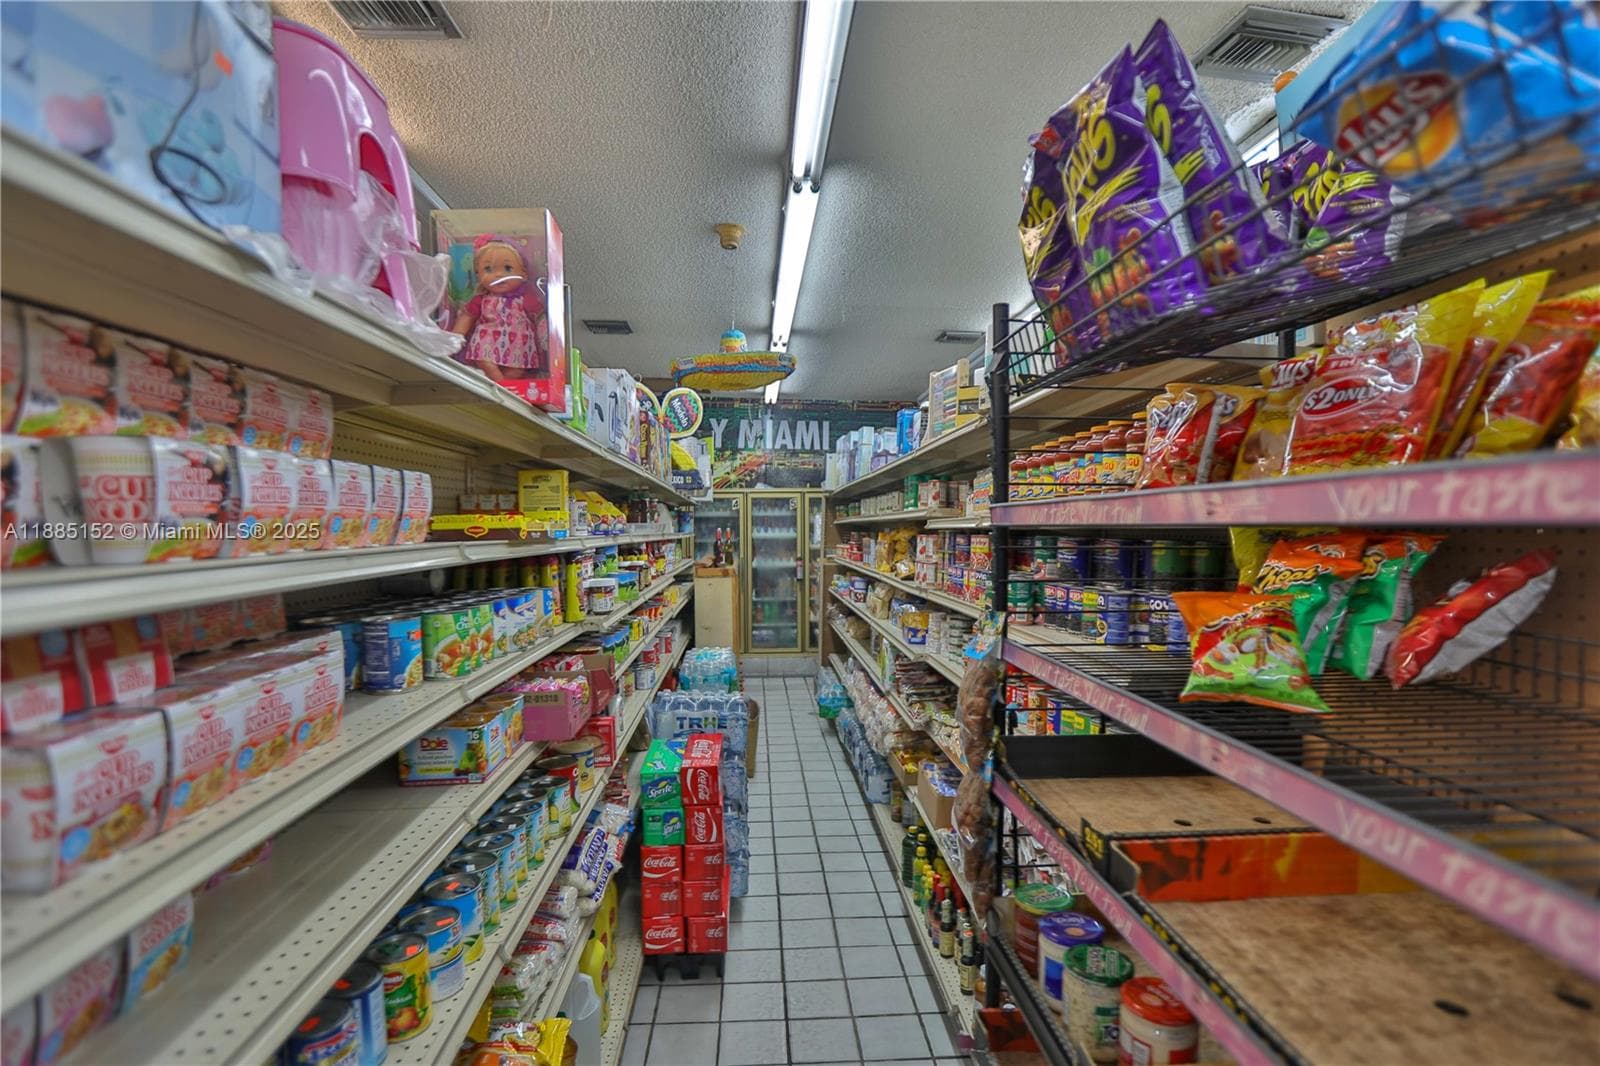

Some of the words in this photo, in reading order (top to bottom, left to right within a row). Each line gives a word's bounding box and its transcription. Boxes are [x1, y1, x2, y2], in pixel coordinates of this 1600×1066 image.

[672, 397, 689, 428] Modelo
[737, 418, 831, 450] MIAMI
[419, 737, 449, 749] Dole
[647, 784, 673, 798] Sprite
[643, 856, 677, 868] Coca-Cola
[645, 926, 679, 939] Coca-Cola
